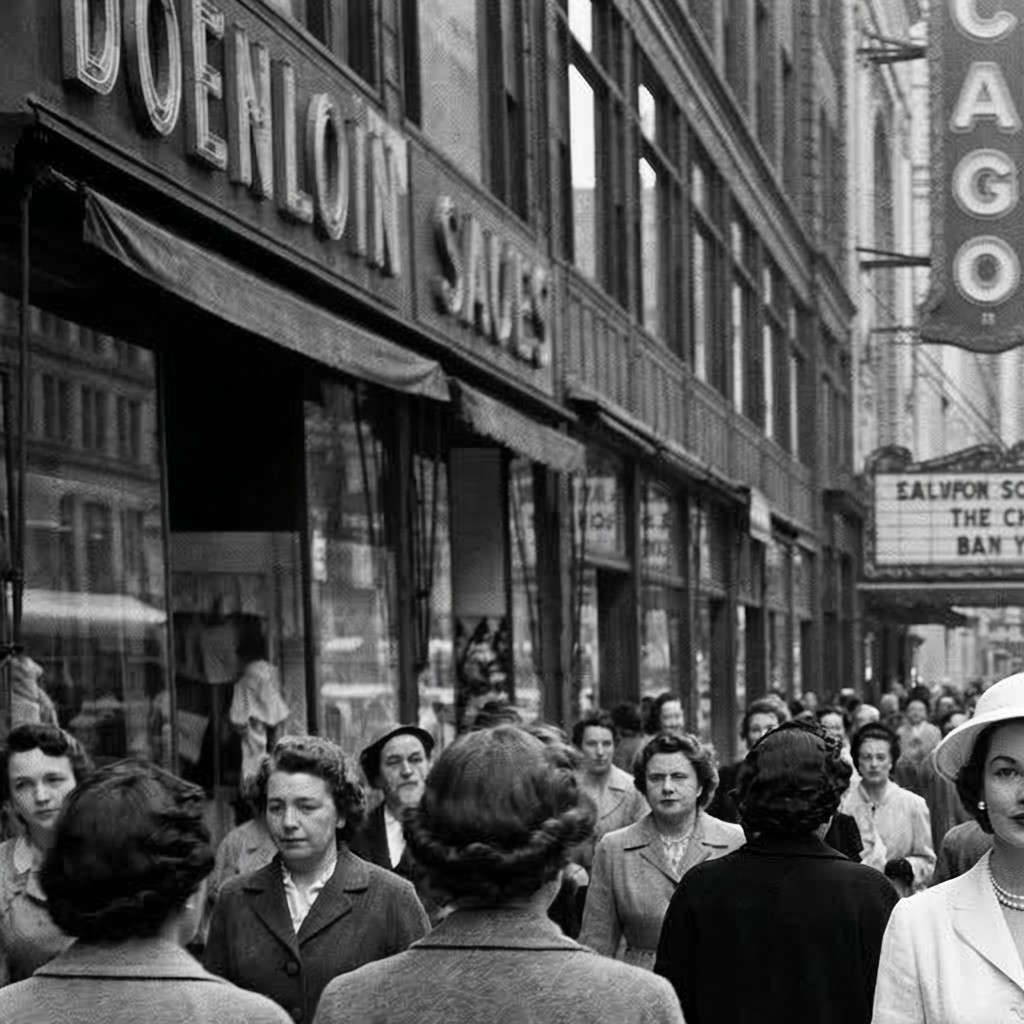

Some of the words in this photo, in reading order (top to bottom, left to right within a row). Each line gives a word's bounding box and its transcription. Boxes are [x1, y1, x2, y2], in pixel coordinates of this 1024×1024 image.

[951, 0, 1023, 307] CAGO
[950, 507, 991, 527] THE
[957, 536, 1001, 556] BAN
